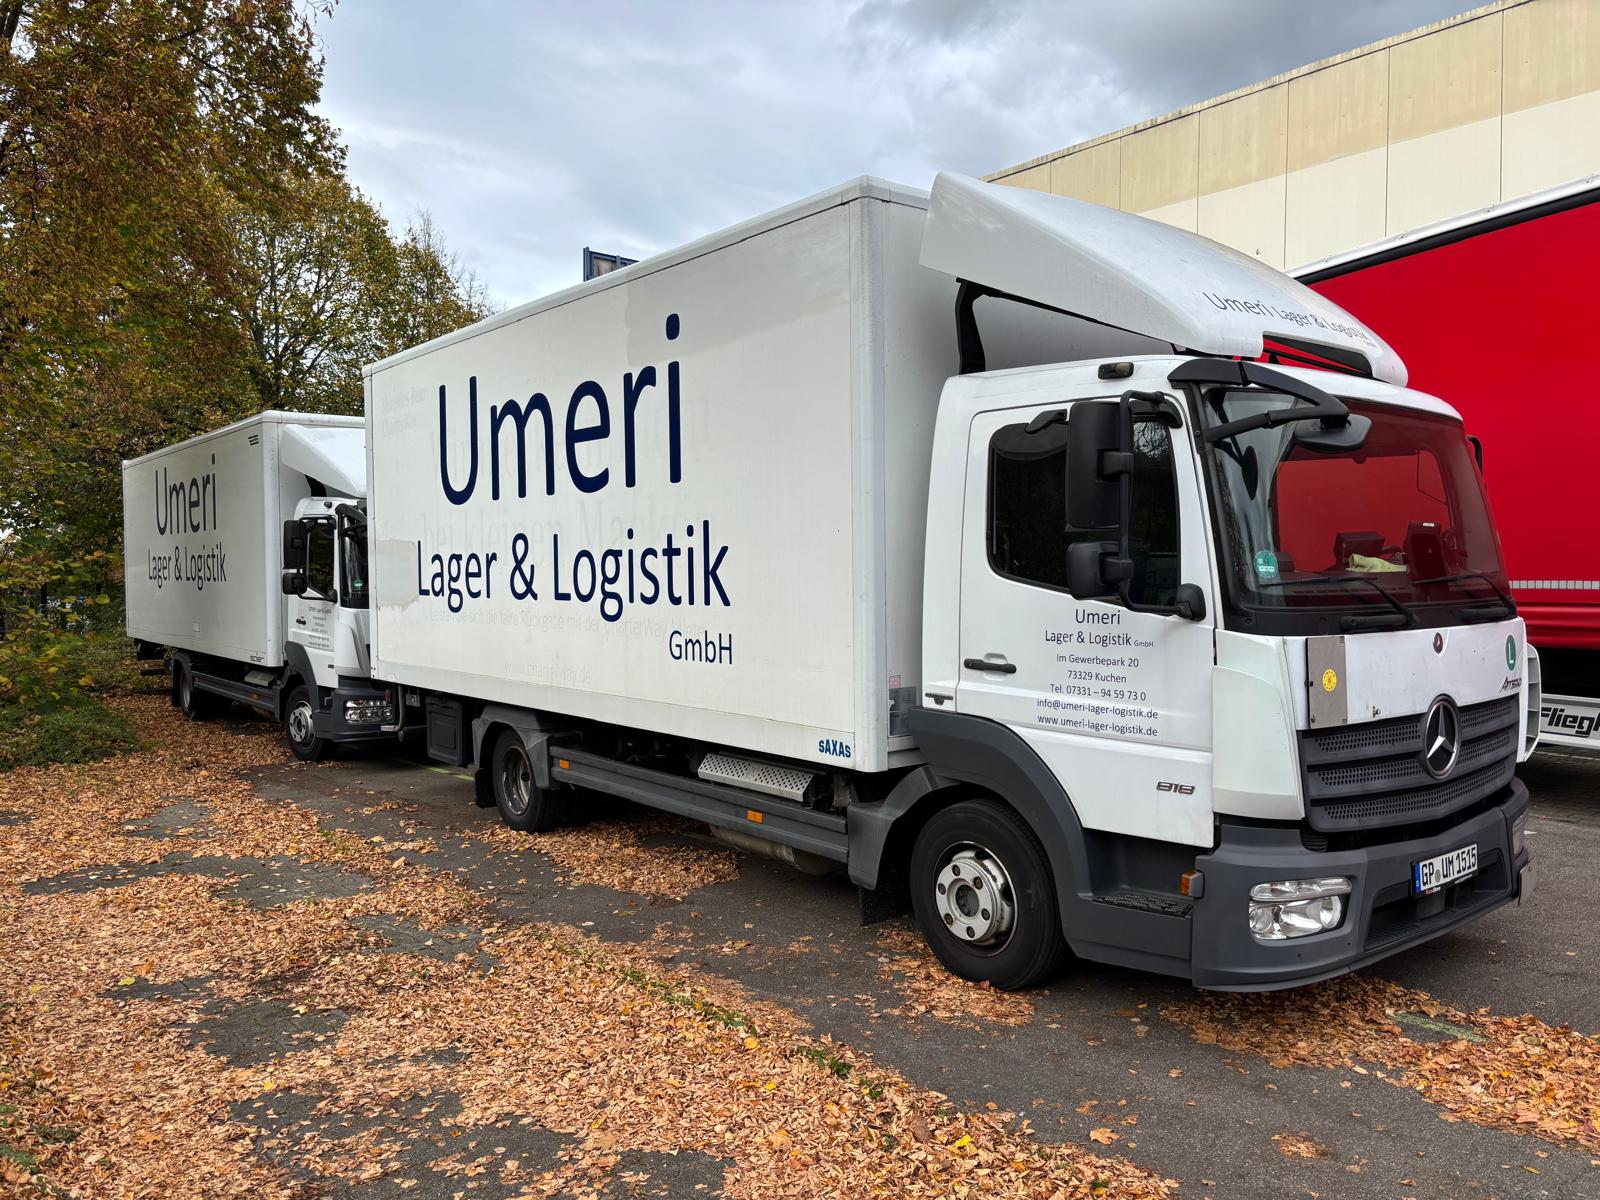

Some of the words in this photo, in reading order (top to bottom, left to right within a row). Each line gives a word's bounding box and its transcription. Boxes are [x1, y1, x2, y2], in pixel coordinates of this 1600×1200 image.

[1202, 291, 1274, 318] Umeri
[1273, 305, 1313, 327] Lager
[1310, 314, 1326, 329] &
[439, 313, 682, 506] Umeri
[155, 453, 217, 536] Umeri
[148, 548, 171, 589] Lager
[174, 545, 183, 583] &
[185, 541, 227, 591] Logistik
[417, 540, 497, 613] Lager
[510, 532, 538, 601] &
[553, 519, 731, 622] Logistik
[1075, 609, 1121, 625] Umeri
[669, 630, 733, 664] GmbH
[1045, 630, 1073, 645] Lager
[1076, 631, 1085, 644] &
[1089, 631, 1132, 648] Logistik
[1133, 639, 1154, 648] GmbH
[1056, 654, 1067, 663] Im
[1068, 654, 1125, 667] Gewerbepark
[1128, 658, 1139, 668] 20
[1067, 670, 1093, 681] 73329
[1095, 672, 1127, 684] Kuchen
[1050, 684, 1064, 694] Tel.
[1066, 686, 1092, 697] 07331
[1100, 688, 1111, 698] 94
[1114, 690, 1125, 700] 59
[1127, 691, 1138, 701] 73
[1140, 691, 1147, 701] 0
[1037, 698, 1159, 719] info@umeri-lager-logistik.de
[1037, 715, 1158, 736] www.umeri-lager-logistik.de
[1156, 781, 1196, 795] 818
[1421, 862, 1434, 886] GP
[1441, 854, 1455, 879] UM
[1455, 846, 1477, 875] 1515
